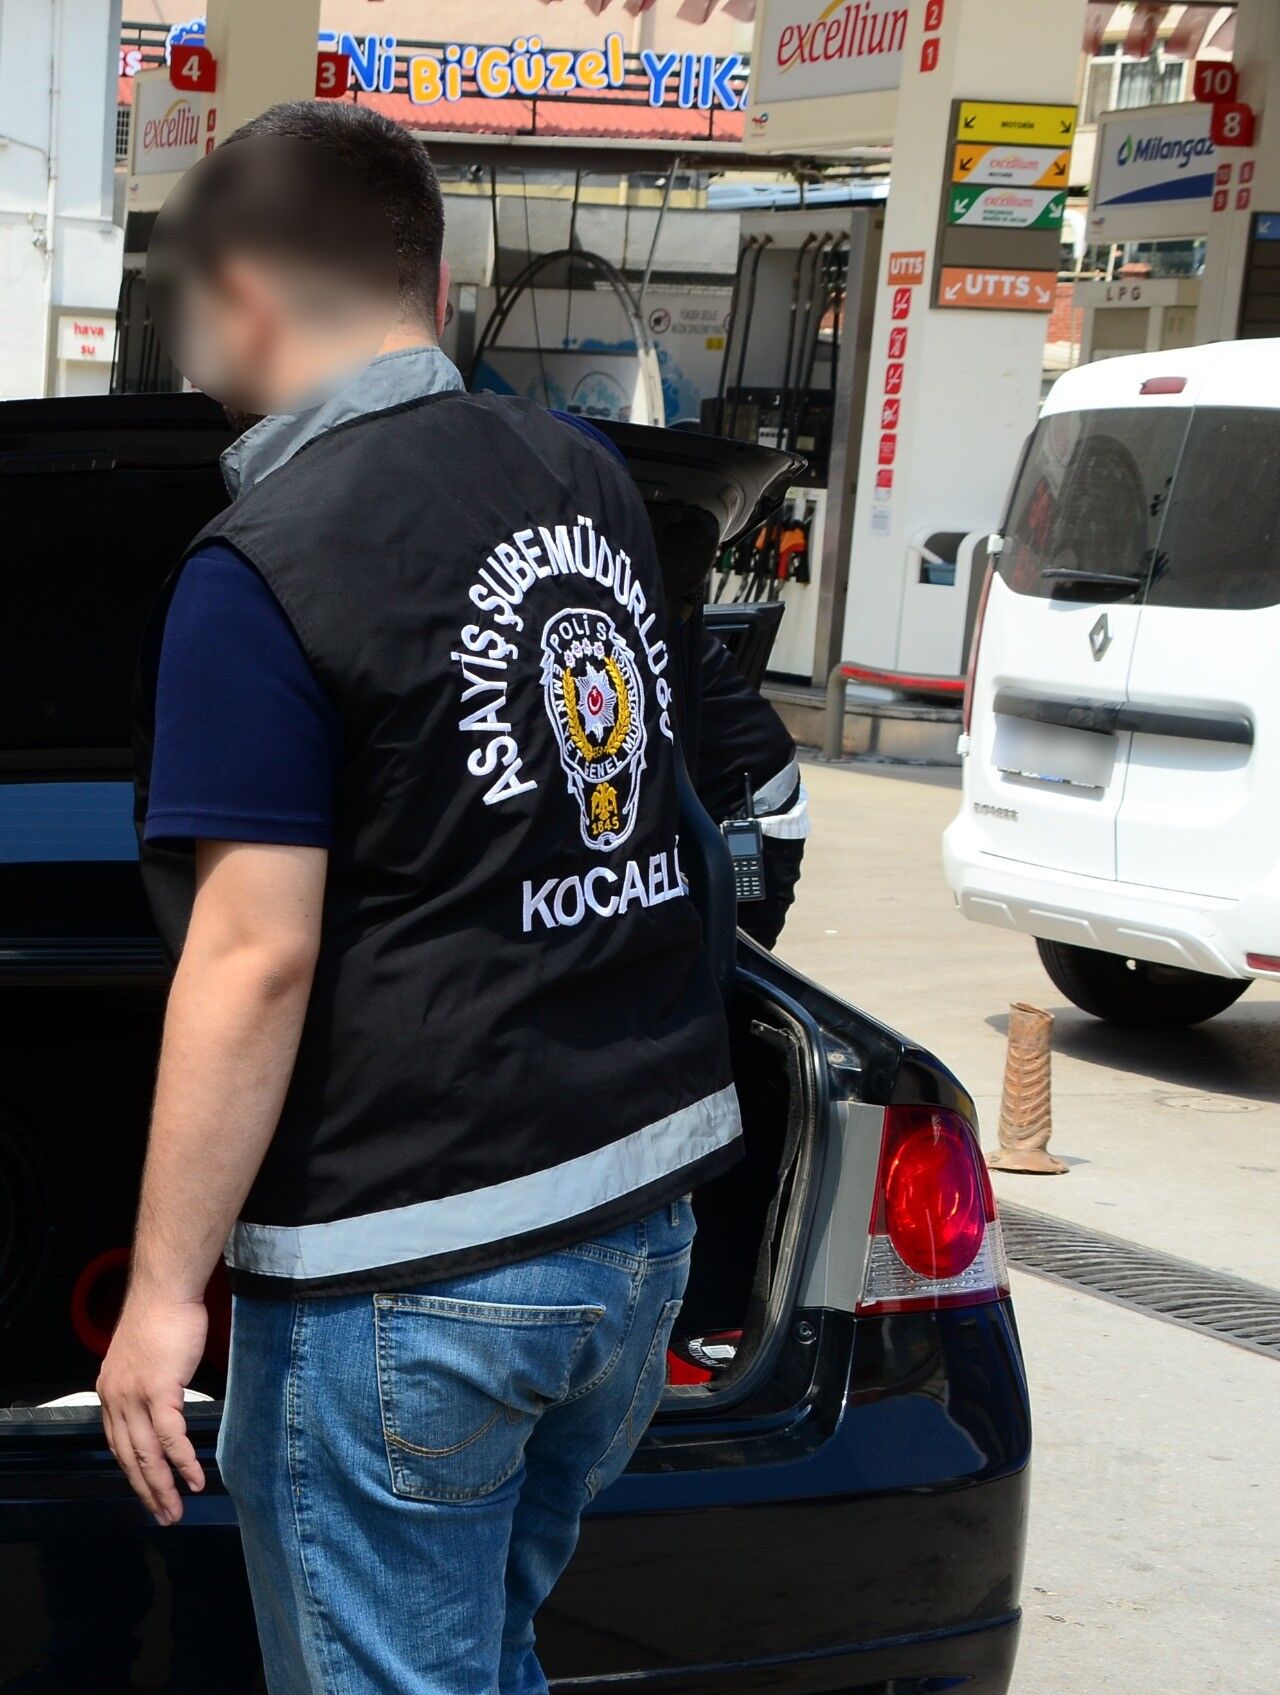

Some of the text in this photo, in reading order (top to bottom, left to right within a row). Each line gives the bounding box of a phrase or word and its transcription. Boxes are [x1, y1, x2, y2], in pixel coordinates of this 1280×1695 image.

[928, 5, 939, 25] 2
[181, 55, 202, 83] 4
[318, 31, 396, 93] Ni
[639, 50, 750, 111] YIK
[319, 61, 336, 89] 3
[1201, 69, 1233, 95] 10
[143, 106, 201, 149] excelliu
[1222, 112, 1242, 138] 8
[1133, 136, 1215, 168] Milangaz
[891, 257, 924, 274] UTTS
[965, 273, 1031, 298] UTTS
[1106, 286, 1141, 301] LPG
[73, 321, 105, 337] hava
[80, 345, 95, 355] su
[450, 624, 539, 806] ASAYİŞ
[591, 816, 620, 835] 1845
